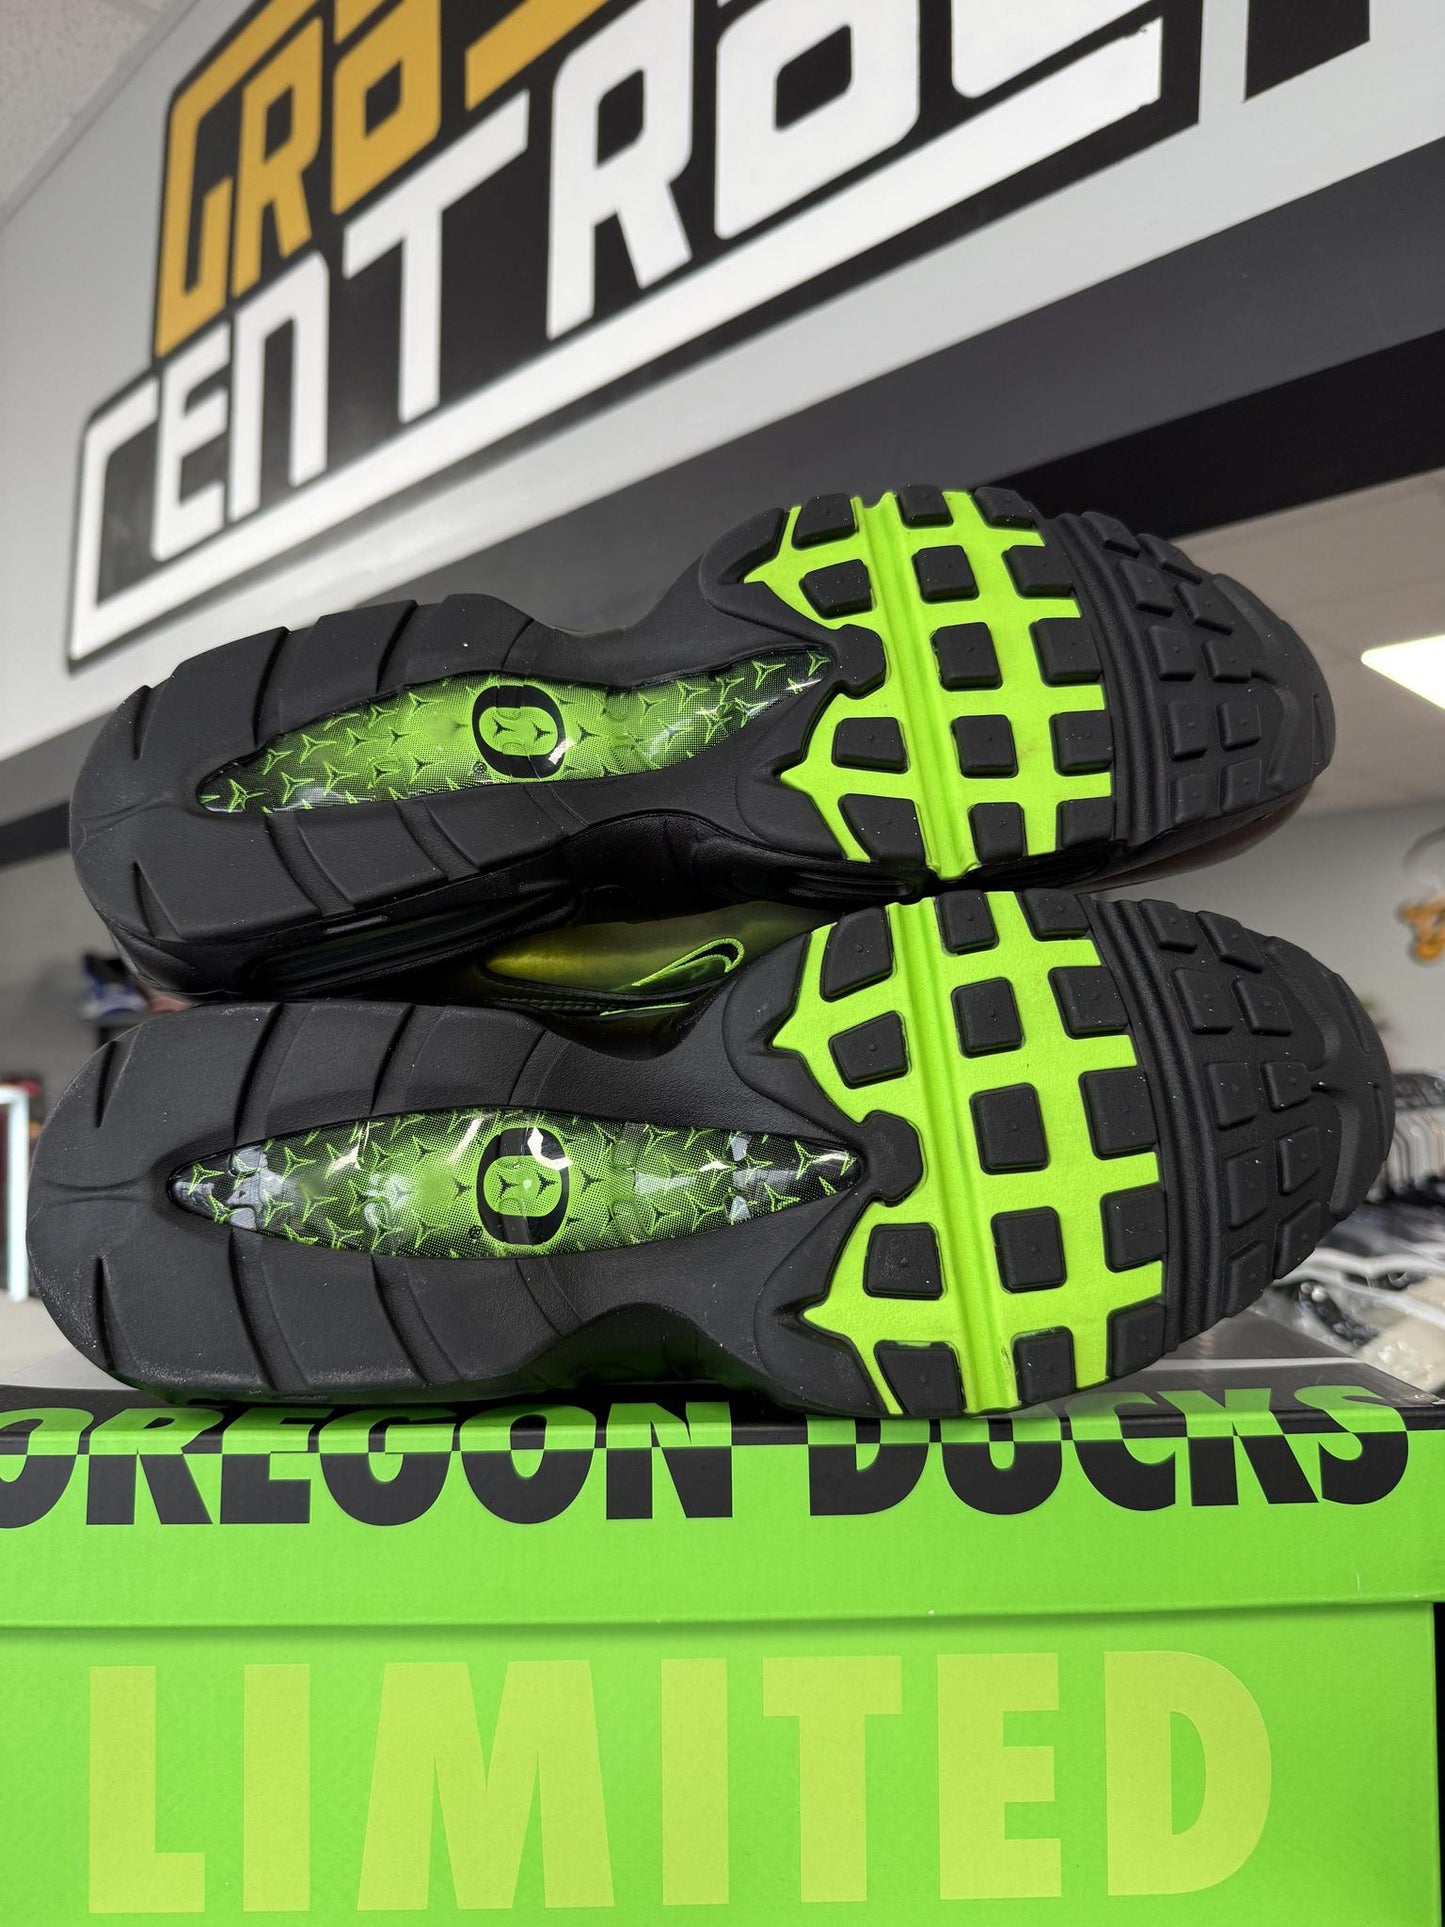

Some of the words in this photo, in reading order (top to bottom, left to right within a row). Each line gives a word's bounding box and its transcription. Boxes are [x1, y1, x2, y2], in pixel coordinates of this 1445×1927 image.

[0, 1402, 733, 1528] OREGON
[806, 1385, 1409, 1516] DUCKS
[88, 1650, 1272, 1914] LIMITED
